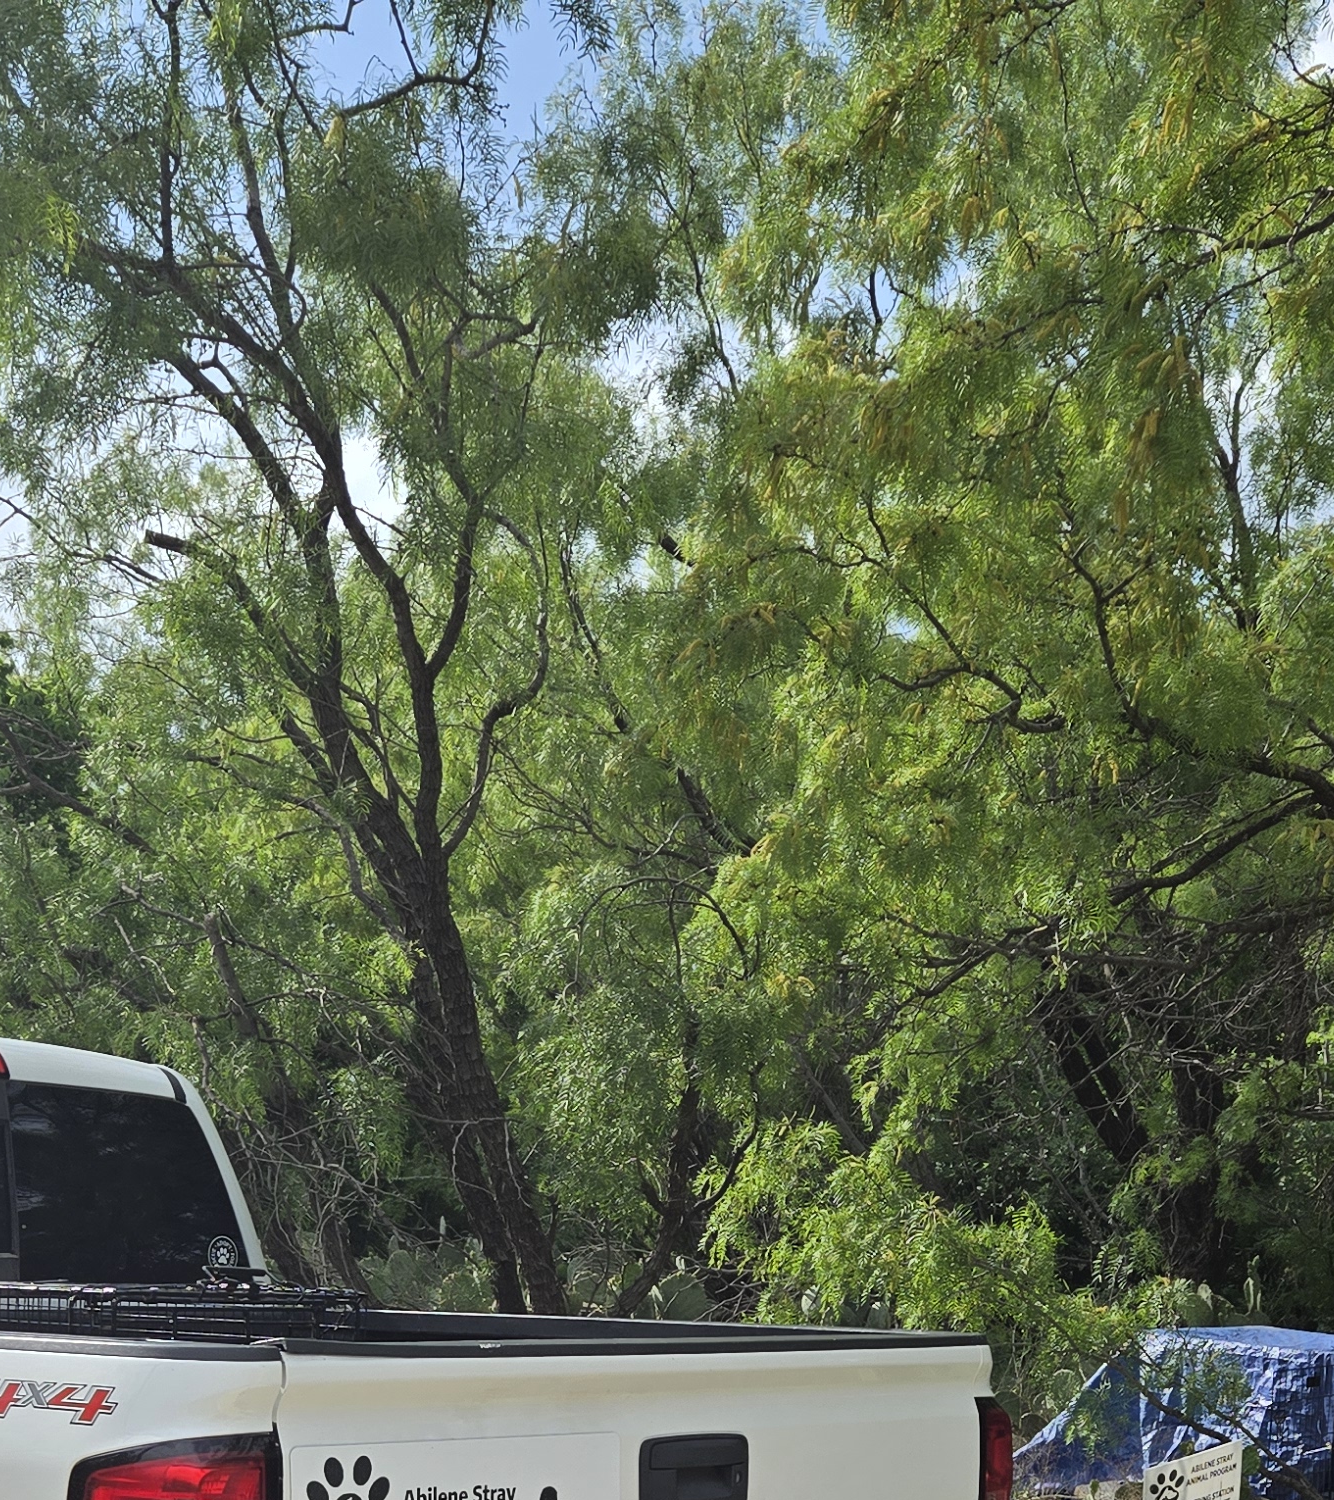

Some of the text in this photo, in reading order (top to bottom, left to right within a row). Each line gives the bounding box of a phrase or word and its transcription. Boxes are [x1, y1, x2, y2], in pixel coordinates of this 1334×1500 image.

[1191, 1453, 1235, 1474] ABILENE STRAY
[1186, 1463, 1238, 1487] ANIMAL PROGRAM
[1211, 1486, 1235, 1500] STATION
